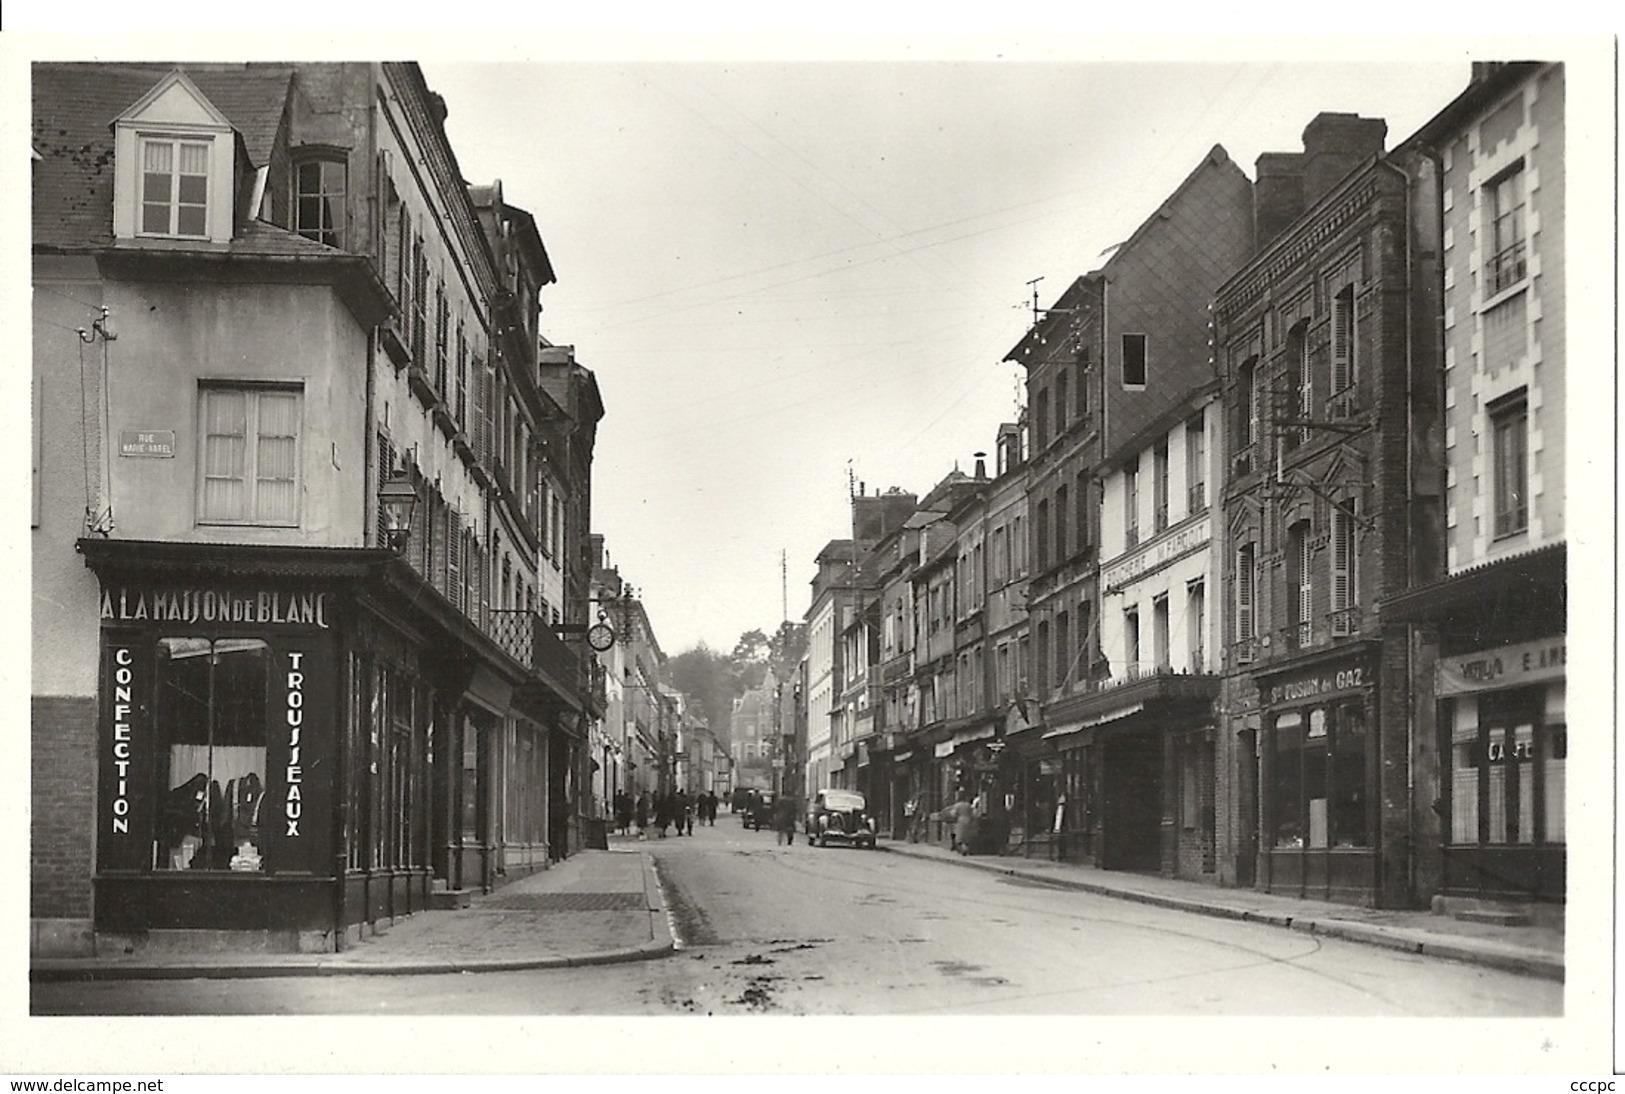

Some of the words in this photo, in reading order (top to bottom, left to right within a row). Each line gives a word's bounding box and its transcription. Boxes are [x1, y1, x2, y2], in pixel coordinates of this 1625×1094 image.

[138, 434, 154, 443] RUE
[100, 588, 115, 620] A
[120, 588, 148, 620] LA
[153, 589, 231, 624] MAISON
[257, 591, 329, 628] BLANC
[1336, 668, 1362, 689] GAZ
[113, 649, 132, 834] CONFECTION
[286, 653, 304, 837] TROUSSEAUX
